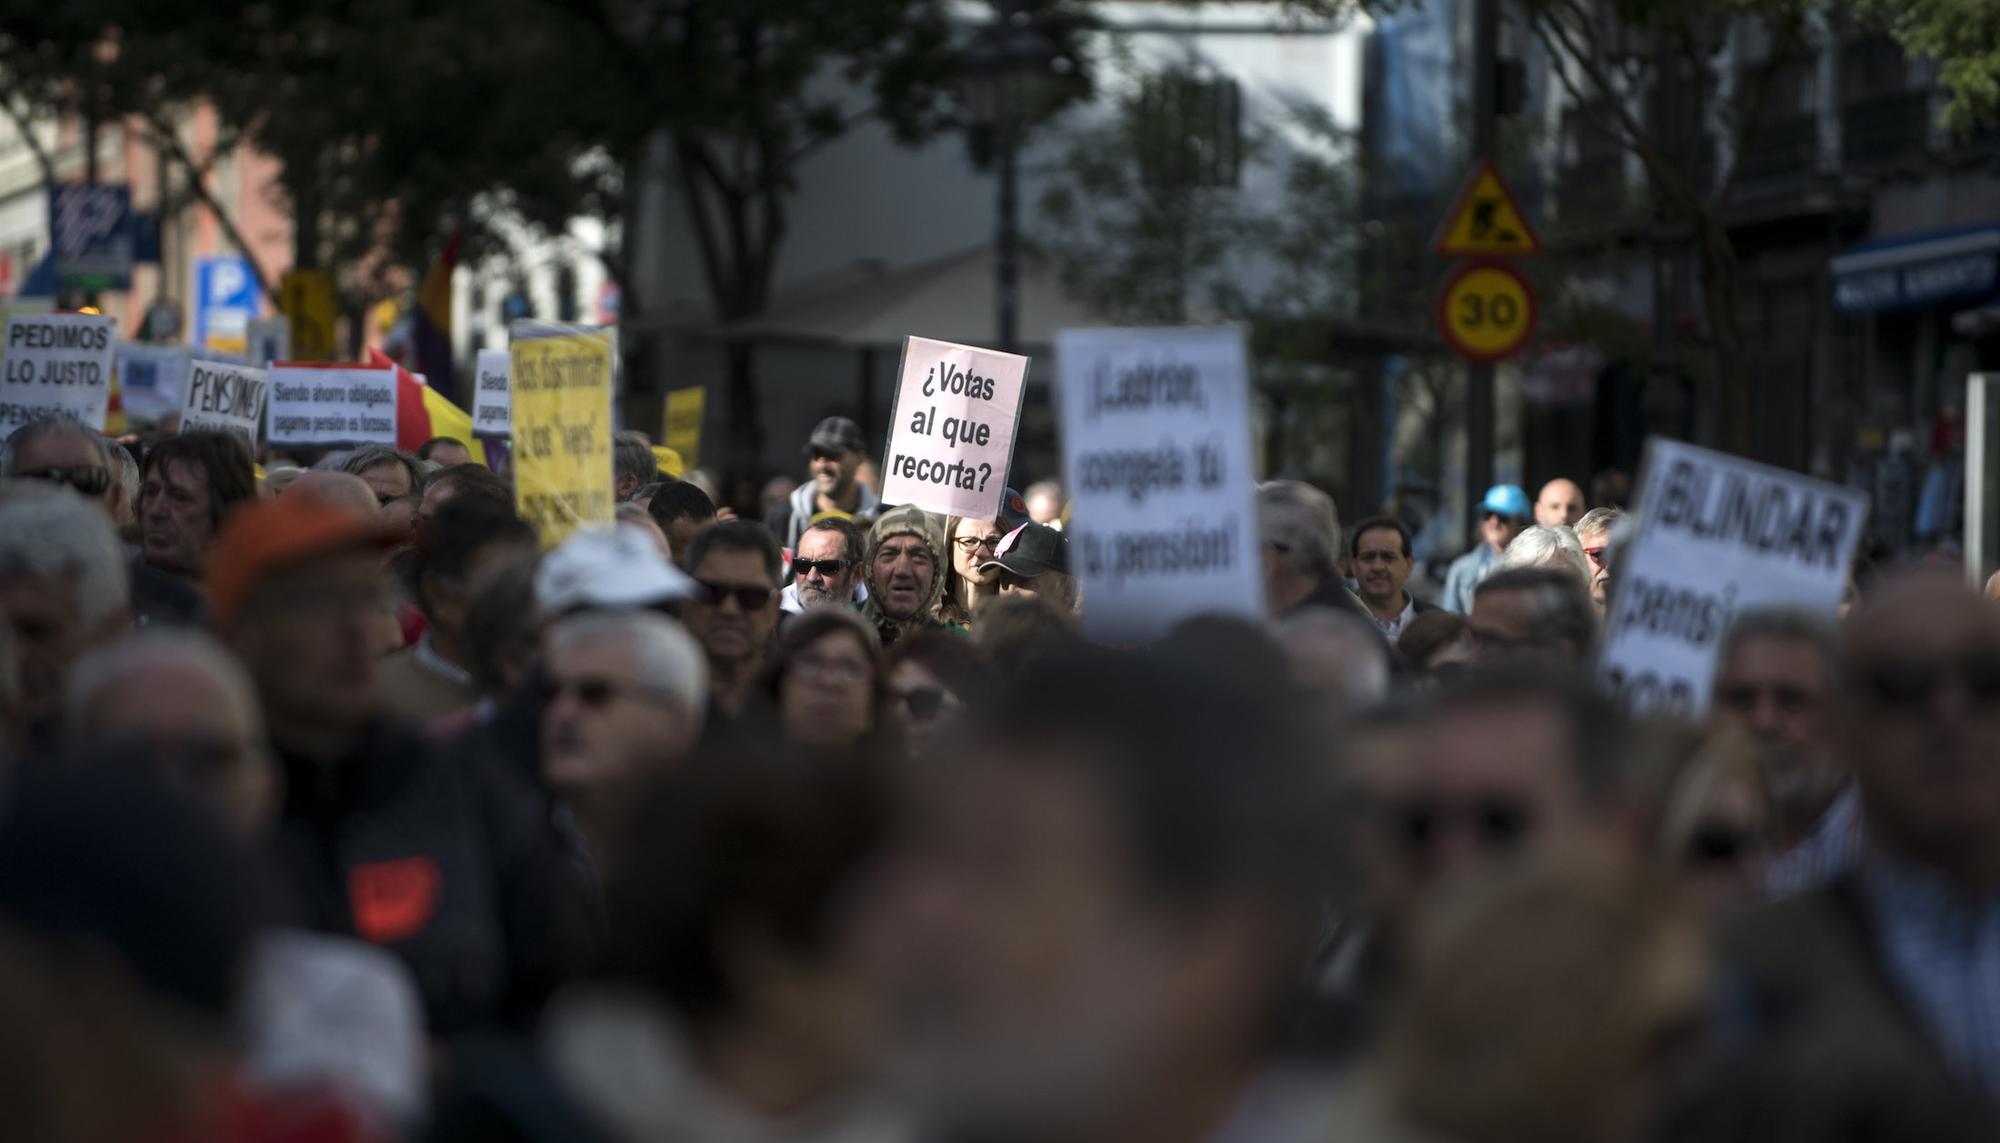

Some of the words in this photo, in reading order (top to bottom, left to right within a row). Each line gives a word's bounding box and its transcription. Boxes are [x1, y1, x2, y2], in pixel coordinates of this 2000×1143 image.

[212, 264, 245, 302] P
[1459, 292, 1518, 329] 30
[9, 324, 108, 350] PEDIMOS
[7, 360, 35, 384] LO
[40, 361, 105, 386] JUSTO.
[480, 370, 507, 391] Siendo
[923, 361, 995, 401] ¿Votas
[274, 382, 309, 402] Siendo
[313, 382, 345, 402] ahorro
[313, 413, 346, 435] pensión
[349, 418, 358, 432] es
[910, 406, 936, 436] al
[942, 416, 990, 448] que
[892, 453, 992, 492] recorta?
[1656, 461, 1848, 569] BLINDAR
